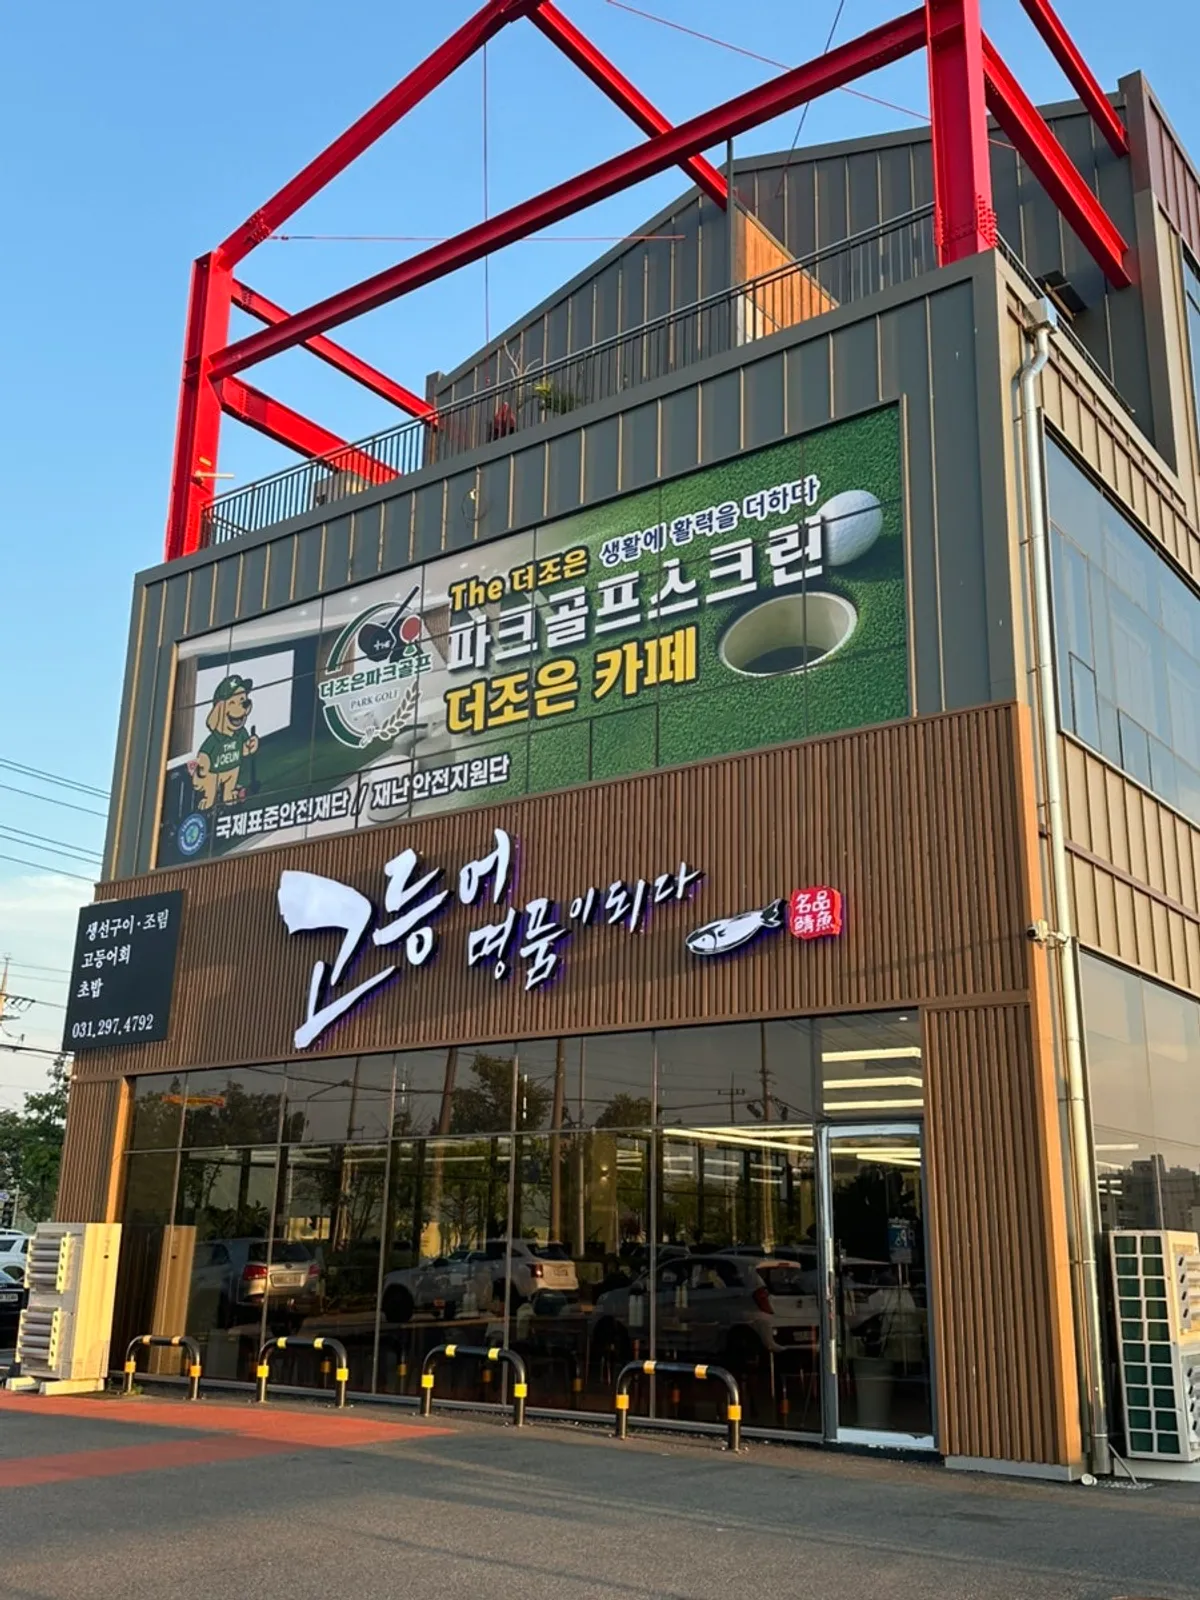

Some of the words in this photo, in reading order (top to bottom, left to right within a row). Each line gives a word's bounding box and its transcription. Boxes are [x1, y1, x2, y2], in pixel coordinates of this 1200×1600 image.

[600, 525, 664, 565] 생활에
[671, 503, 738, 543] 활력을
[745, 475, 819, 518] 더하다
[446, 514, 824, 672] 파크골프스크린
[450, 578, 503, 611] The
[510, 548, 588, 591] 더조은
[320, 654, 432, 698] 더조은파크골프
[445, 658, 579, 733] 더조은
[593, 626, 697, 699] 카페
[350, 694, 373, 709] PARK
[223, 740, 237, 752] THE
[214, 788, 351, 839] 국제표준안전재단
[795, 890, 831, 914] 名品
[80, 944, 132, 969] 고등어회
[278, 828, 510, 1049] 고등어
[76, 977, 104, 999] 초밥
[71, 1013, 155, 1039] 031.297.4792
